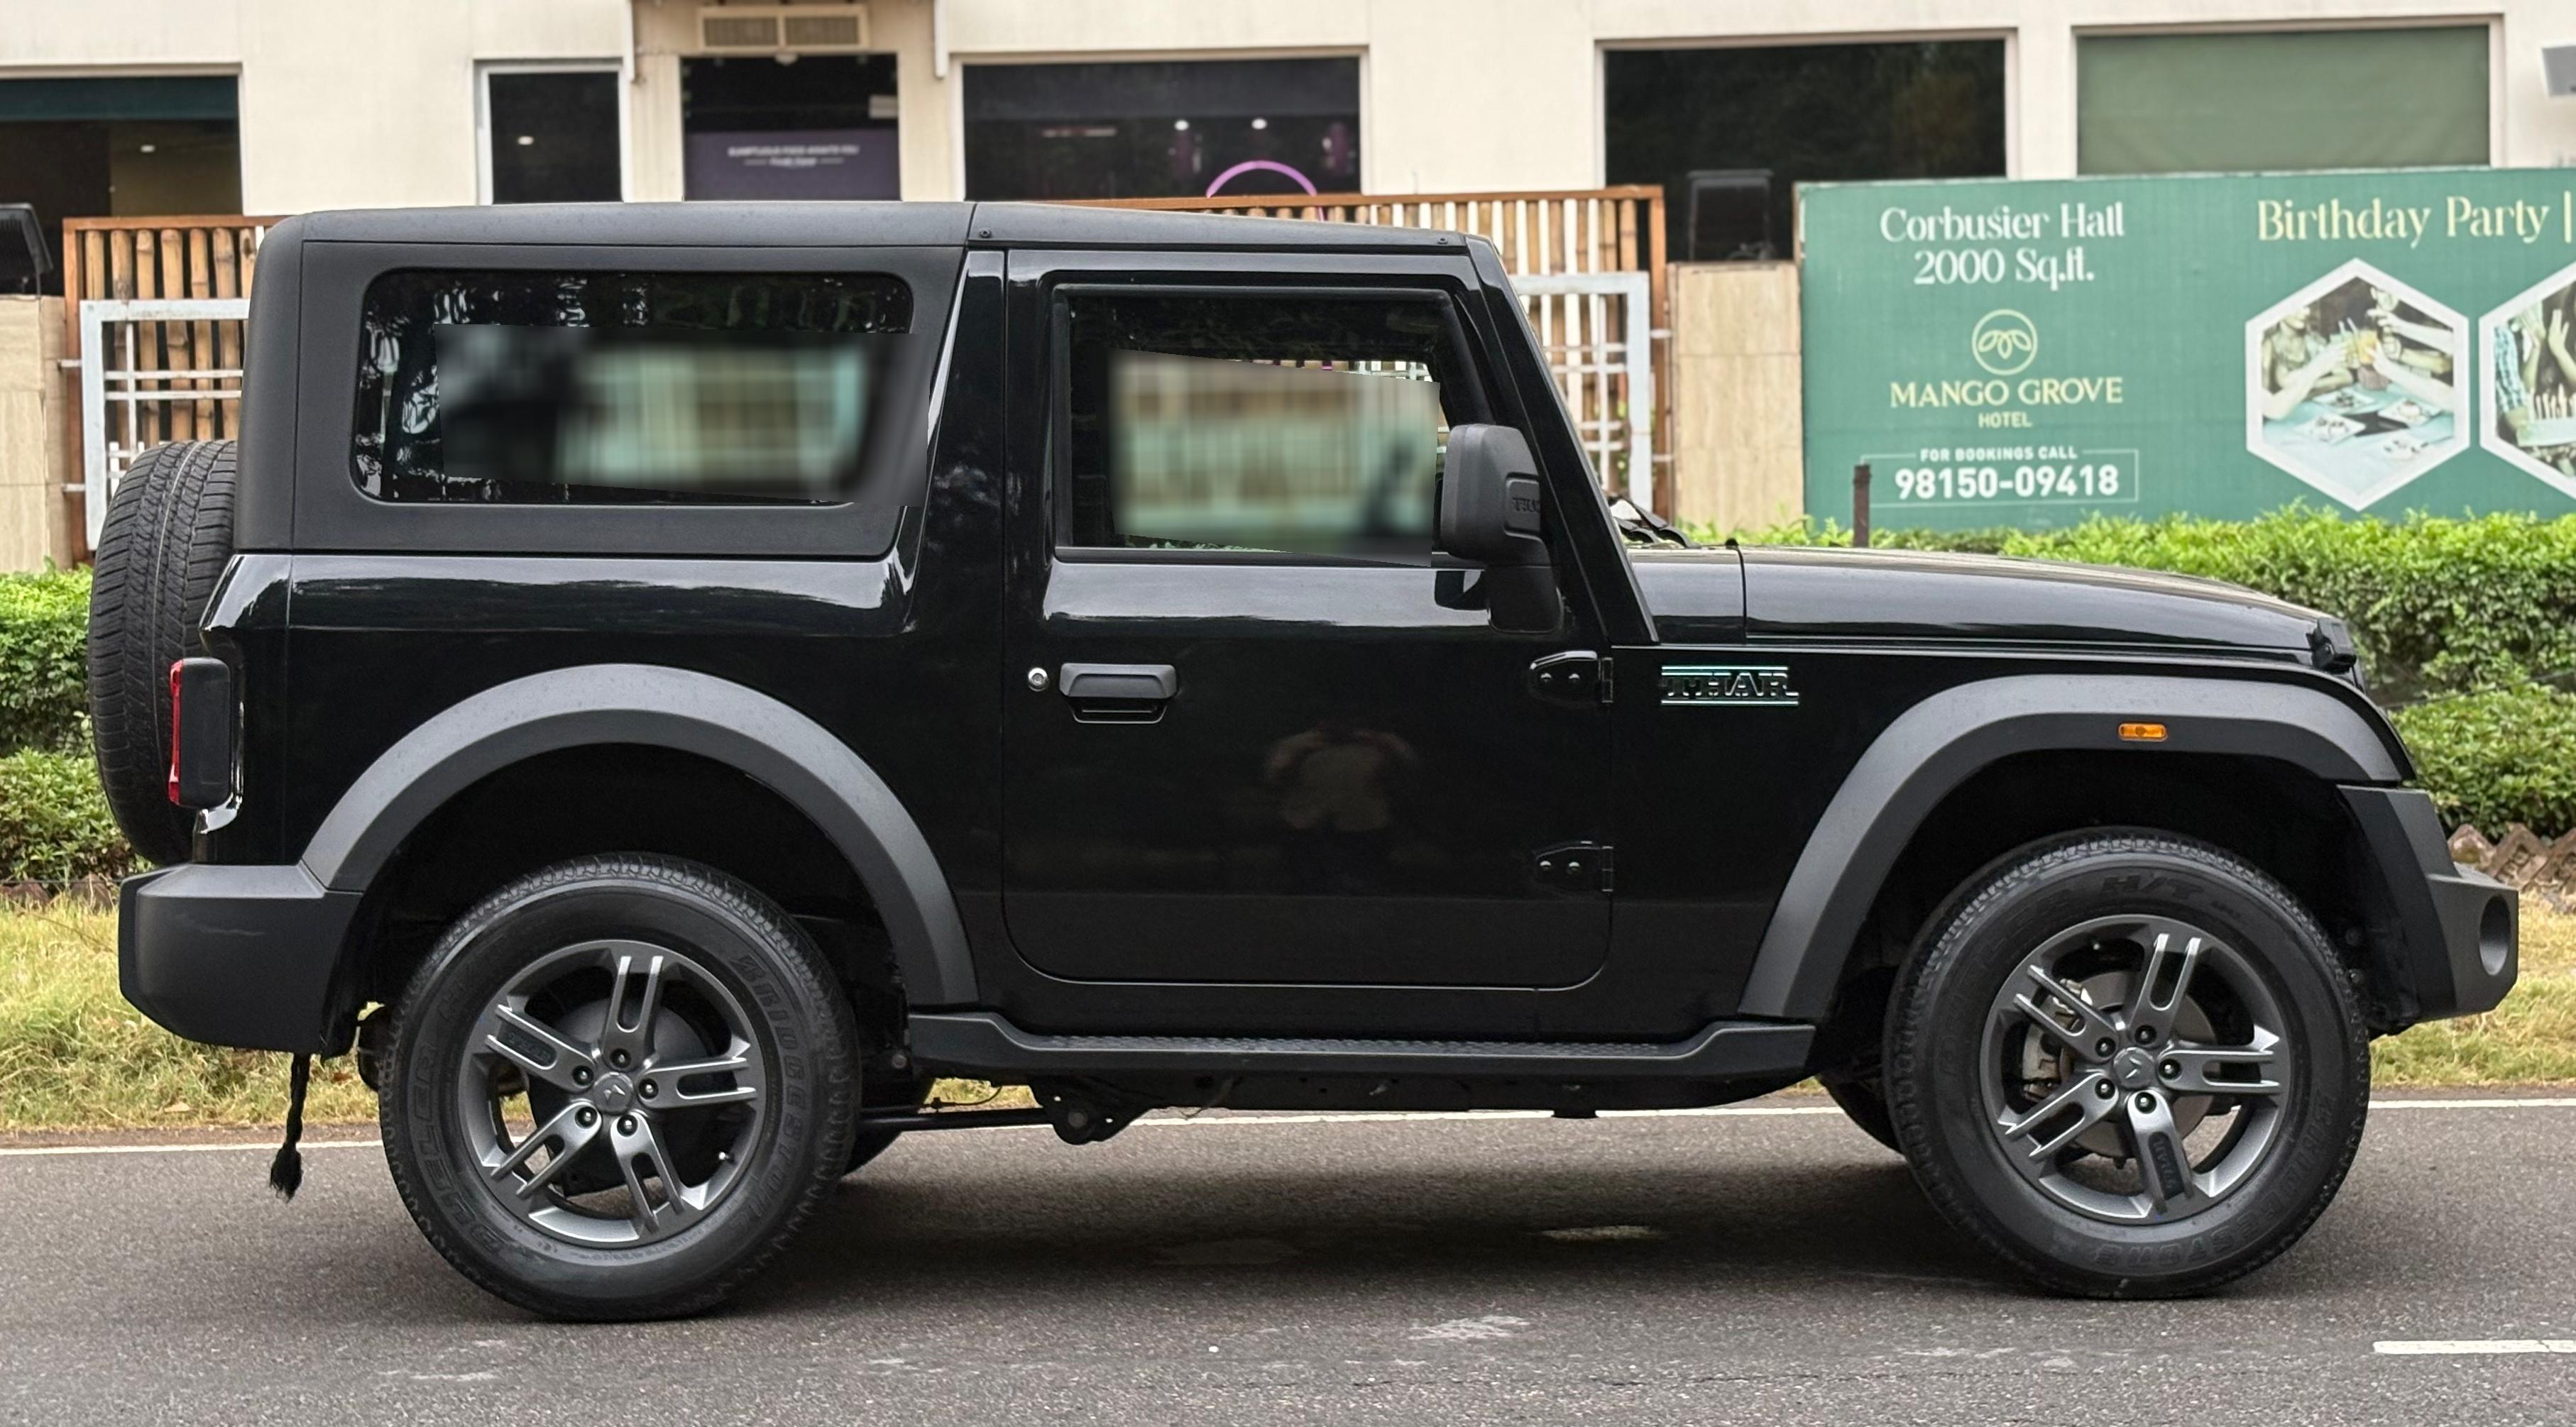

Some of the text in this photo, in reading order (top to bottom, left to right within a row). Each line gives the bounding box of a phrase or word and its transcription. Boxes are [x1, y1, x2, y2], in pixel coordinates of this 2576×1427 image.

[1880, 201, 2125, 242] Corbusier Hall
[2257, 197, 2432, 248] Birthday
[2446, 196, 2550, 244] Party
[1914, 246, 2095, 292] 2000 Sq.ft.
[1890, 376, 2124, 409] MANGO GROVE
[1978, 411, 2033, 429] HOTEL
[1919, 446, 2078, 463] FOR BOOKINGS CALL
[1894, 463, 2120, 500] 98150-09418
